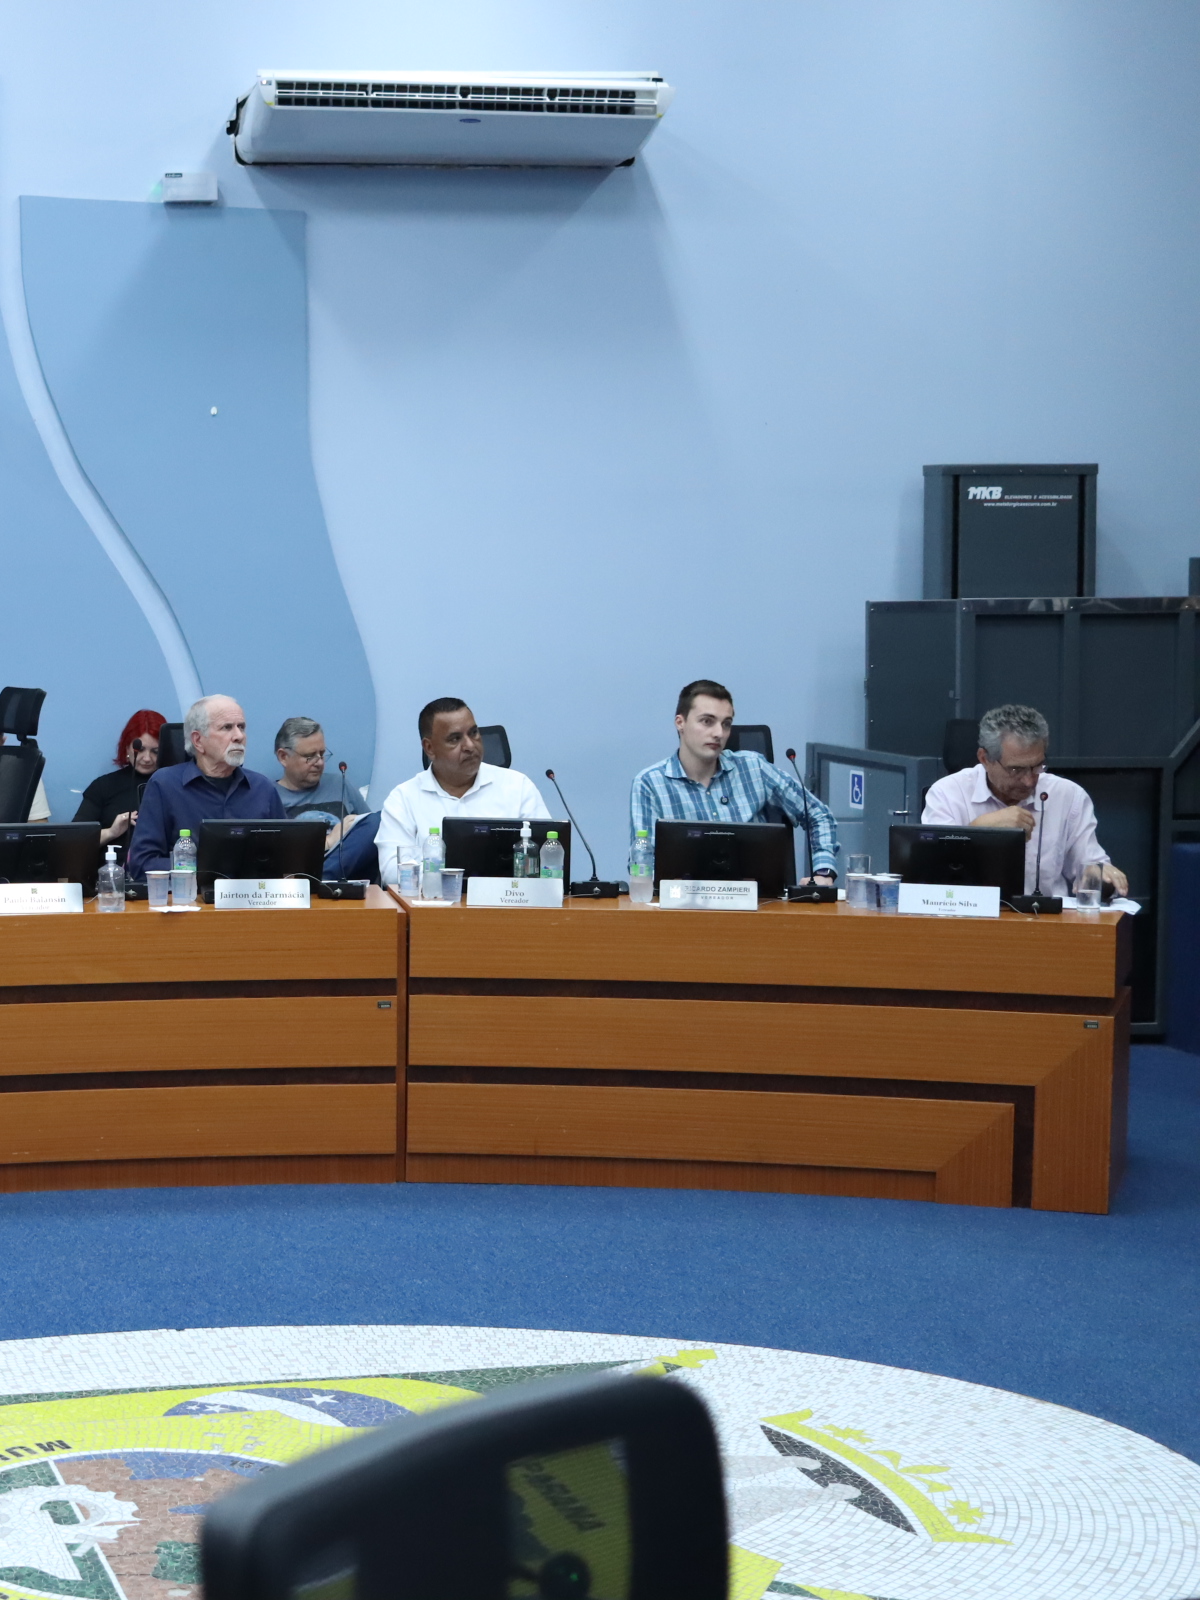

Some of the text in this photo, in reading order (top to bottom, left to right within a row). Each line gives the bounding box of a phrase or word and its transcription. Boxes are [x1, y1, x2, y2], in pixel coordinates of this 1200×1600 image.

[967, 486, 1003, 500] MKB
[220, 891, 305, 900] Jairton da Farmácia
[505, 889, 525, 897] Divo
[958, 900, 978, 908] Silva
